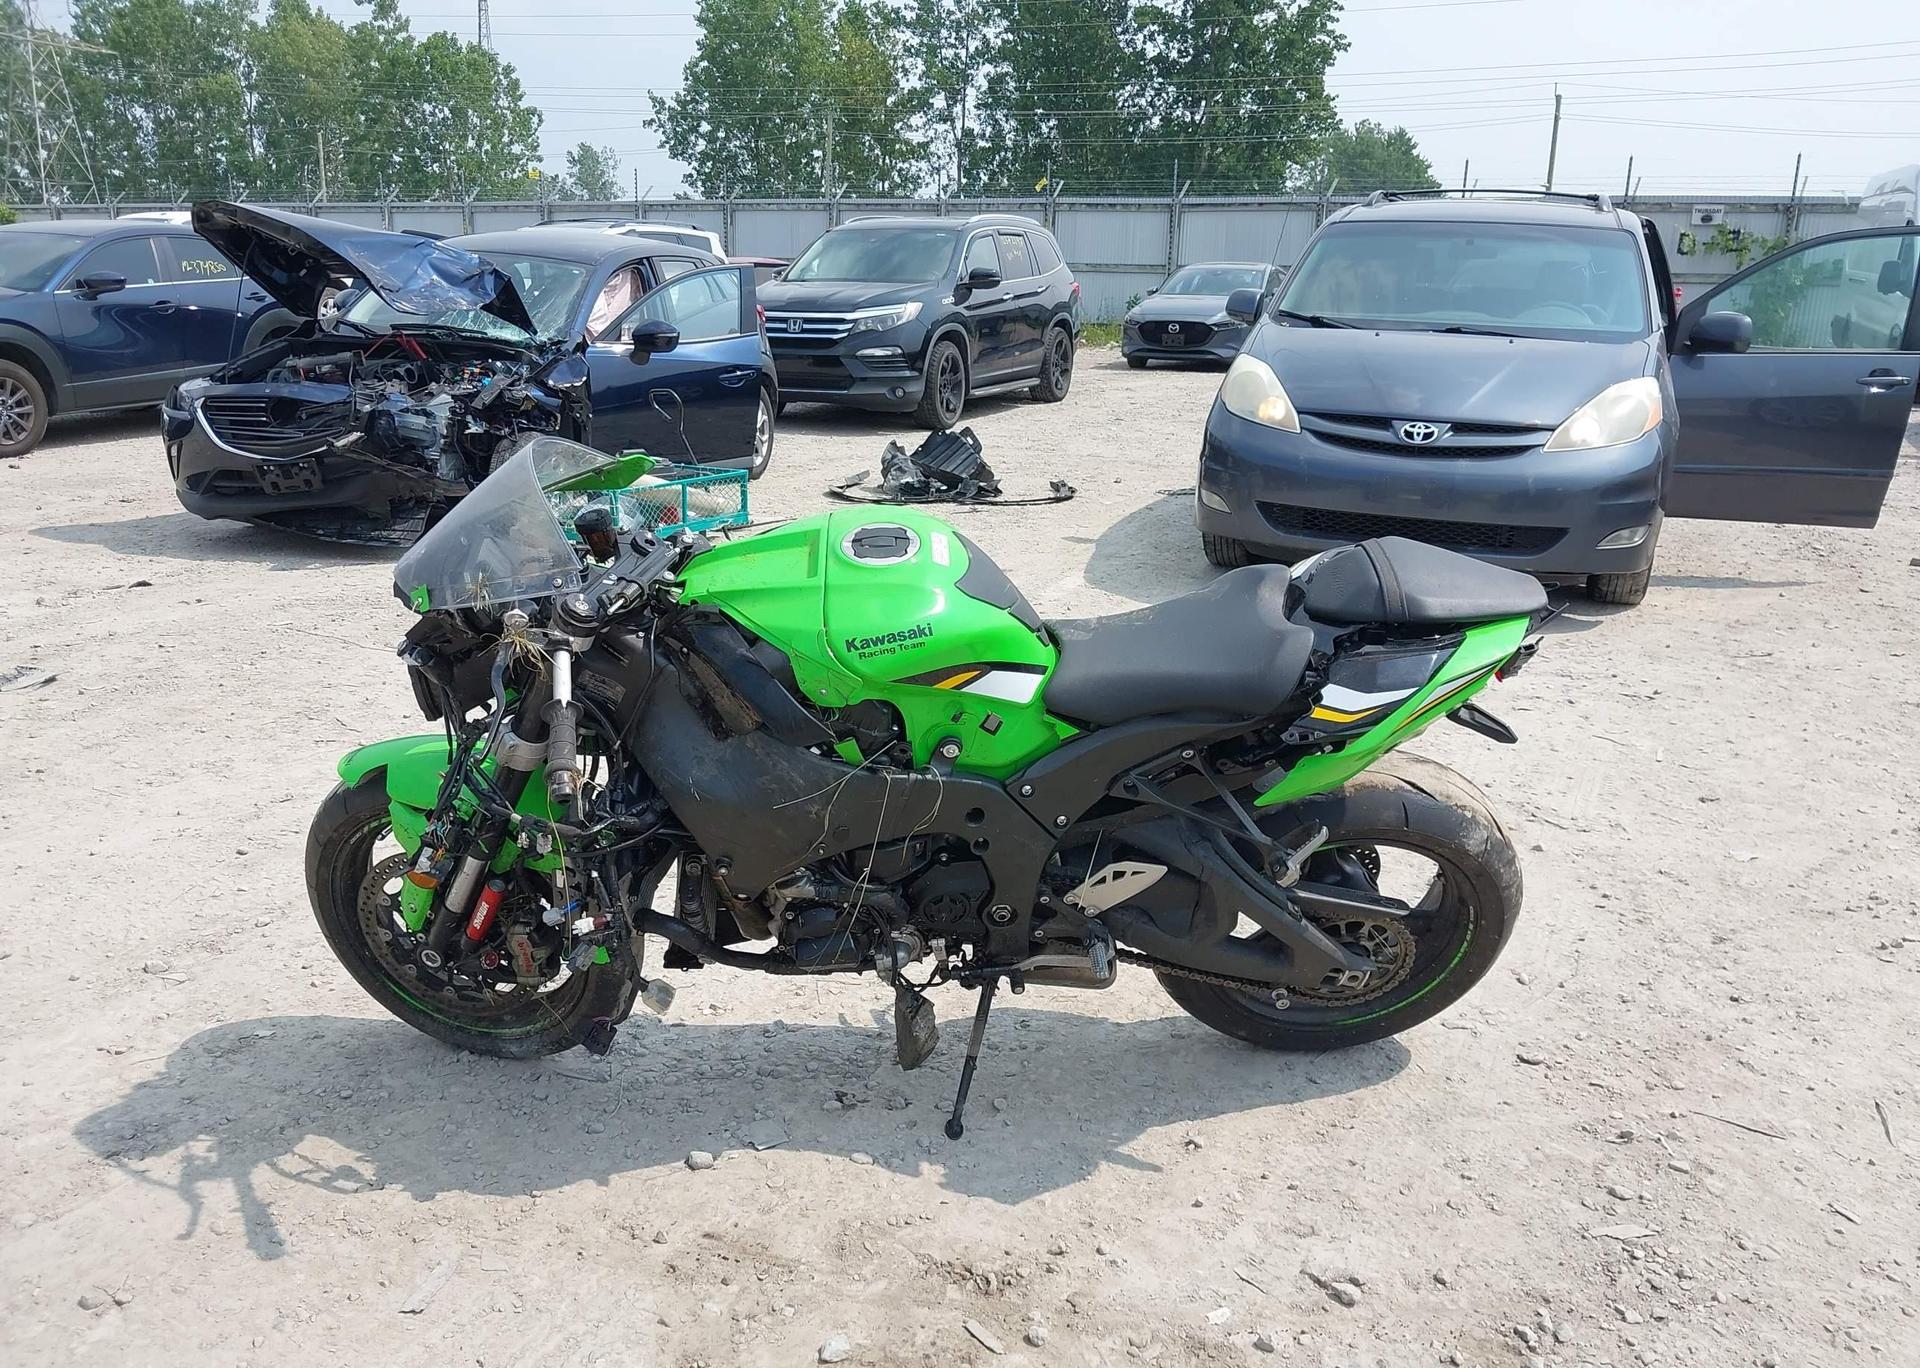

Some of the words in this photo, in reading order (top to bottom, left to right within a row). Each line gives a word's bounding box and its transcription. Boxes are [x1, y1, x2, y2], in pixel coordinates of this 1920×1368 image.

[845, 622, 934, 653] Kawasaki
[858, 645, 896, 660] Racing
[898, 641, 926, 652] Team
